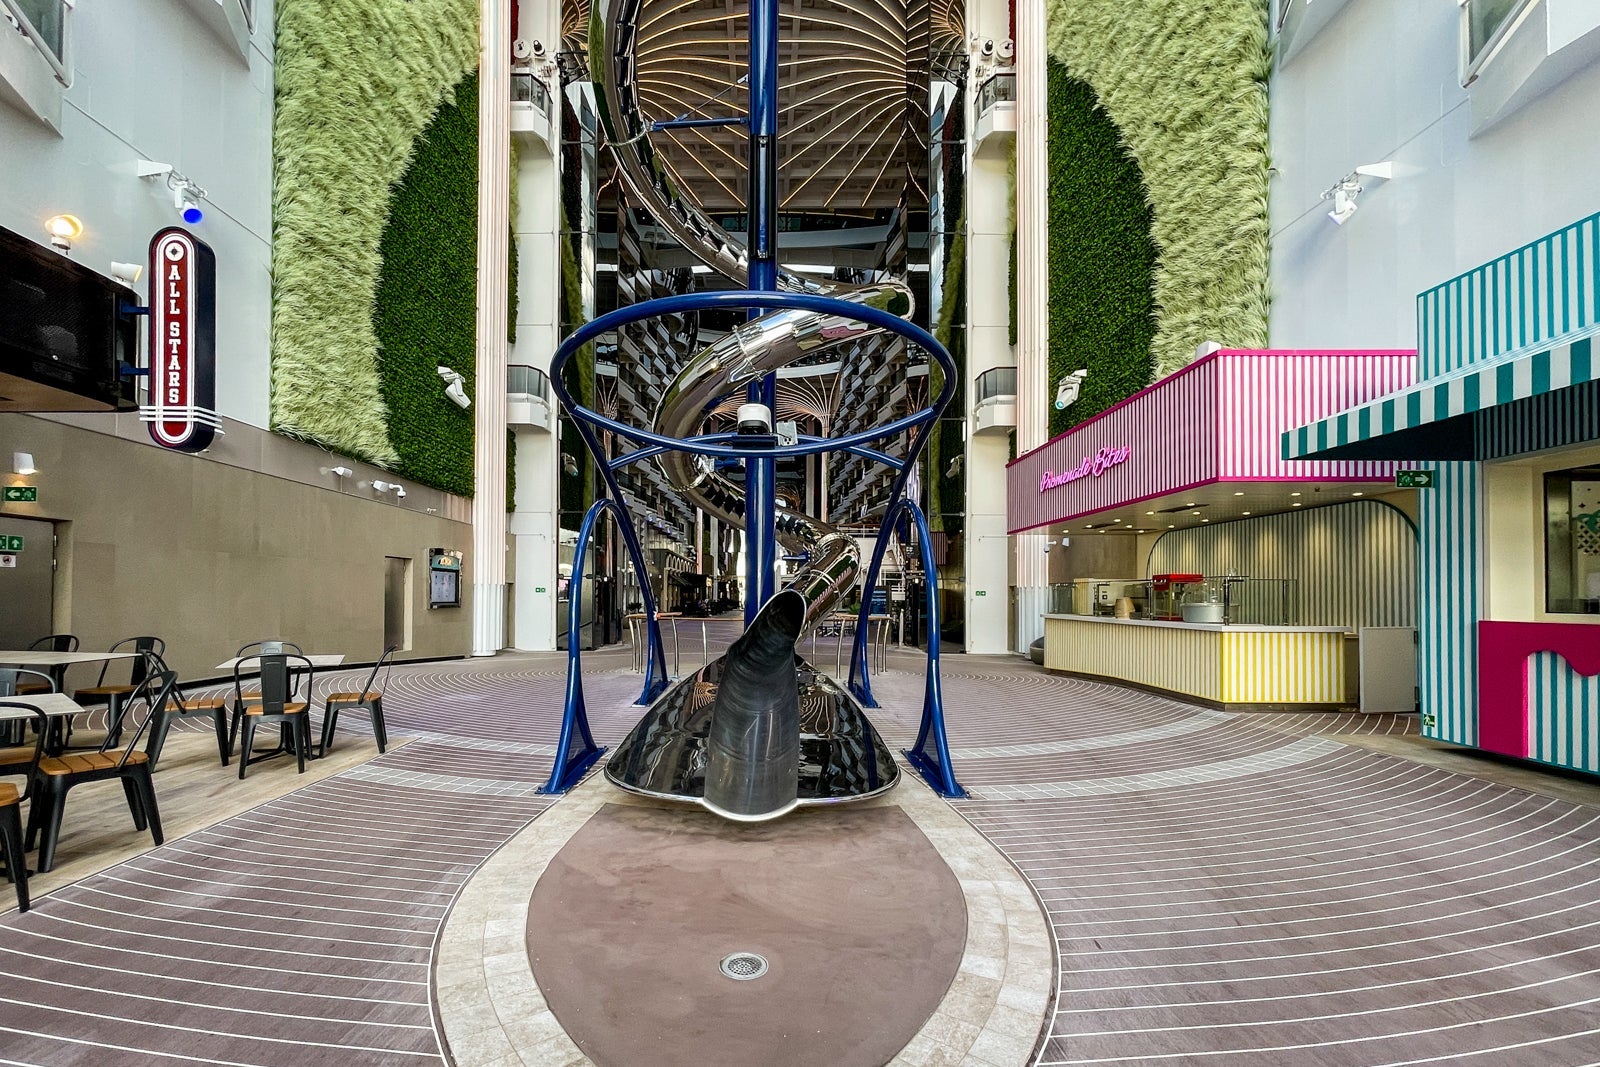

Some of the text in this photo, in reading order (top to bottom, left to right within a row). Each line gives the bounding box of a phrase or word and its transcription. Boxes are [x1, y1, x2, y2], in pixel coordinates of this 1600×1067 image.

[168, 264, 182, 404] ALL STARS
[1040, 446, 1131, 493] Promenade Bites
